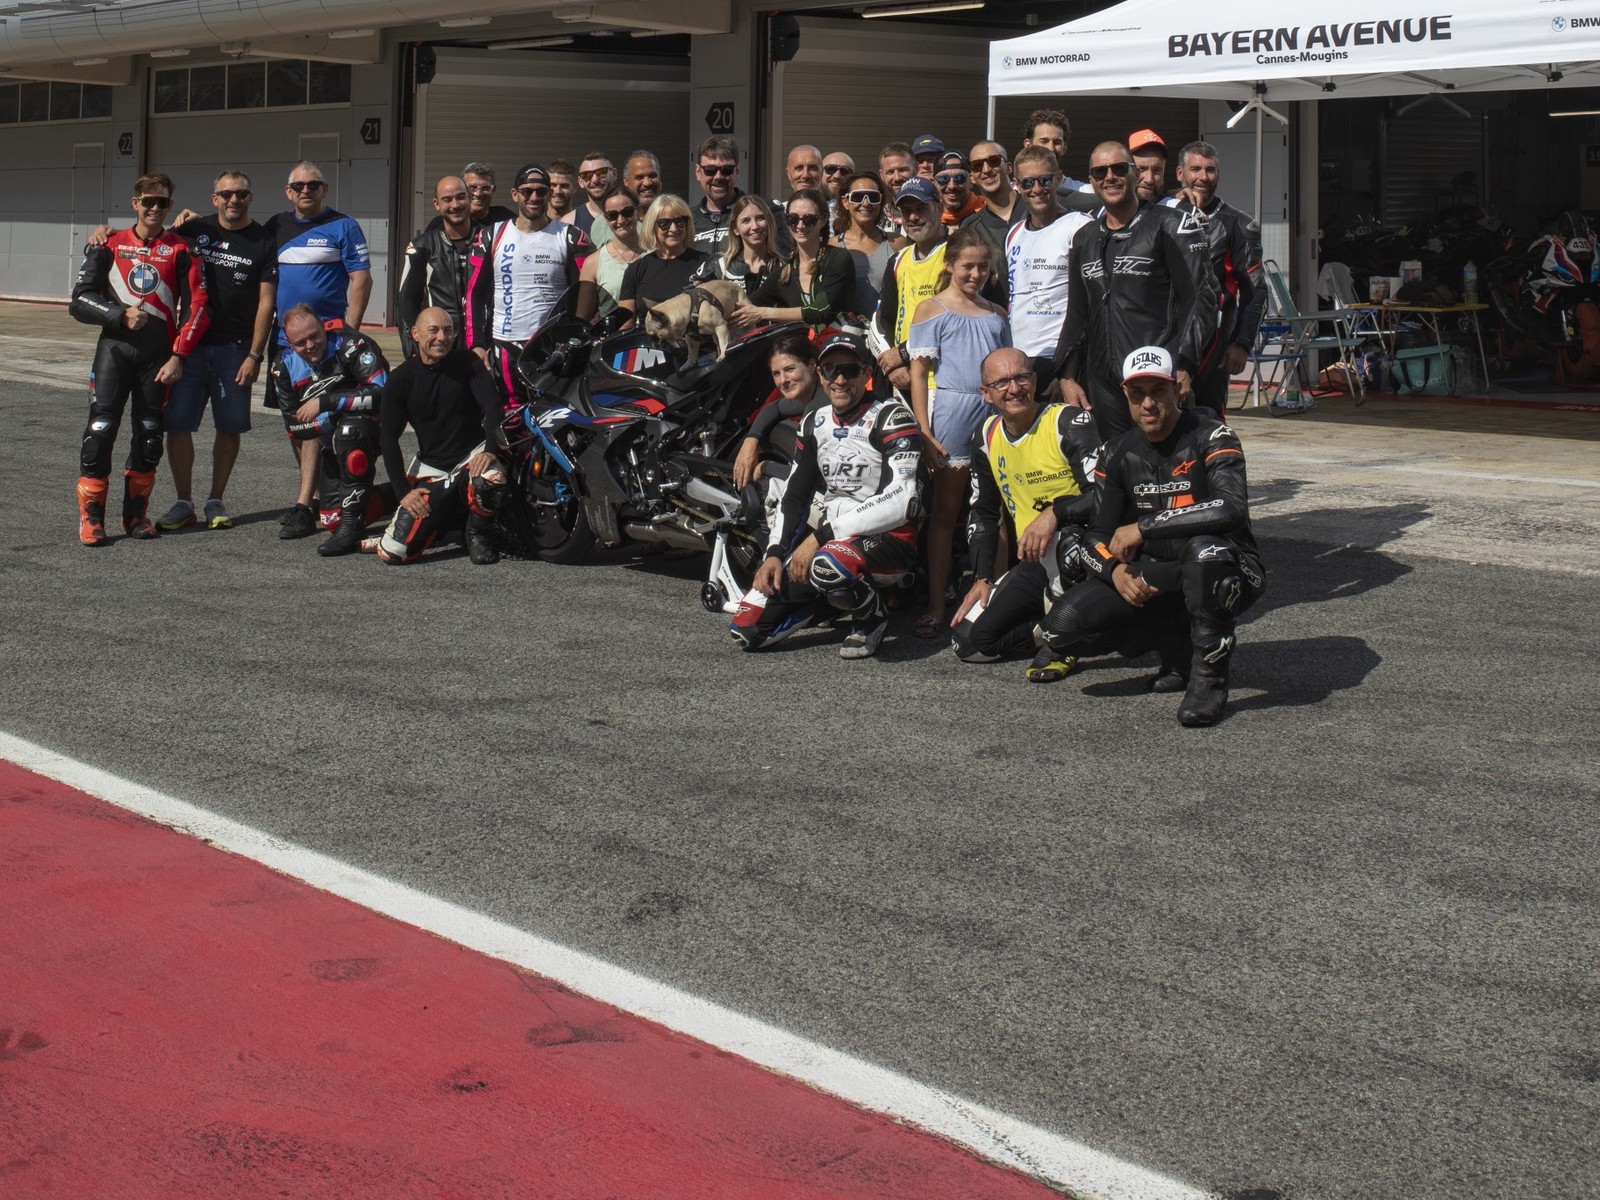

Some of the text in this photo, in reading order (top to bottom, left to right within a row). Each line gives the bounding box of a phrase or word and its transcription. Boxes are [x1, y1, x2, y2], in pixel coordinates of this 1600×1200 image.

[1570, 17, 1600, 28] BMW
[1168, 14, 1453, 58] BAYERN AVENUE
[1015, 53, 1090, 66] BMW MOTORRAD
[1256, 49, 1348, 65] Cannes-Mougins
[712, 107, 732, 129] 20
[365, 122, 378, 140] 21
[120, 136, 132, 151] 22
[1573, 240, 1590, 249] 435
[211, 251, 252, 266] MOTORRAD
[501, 242, 516, 335] TRACKDAYS
[1130, 351, 1162, 369] ASTARS
[1025, 470, 1043, 479] BMW
[1027, 470, 1068, 485] MOTORRAD
[1133, 481, 1191, 494] alpinestars
[856, 486, 904, 513] BMW Motorrad
